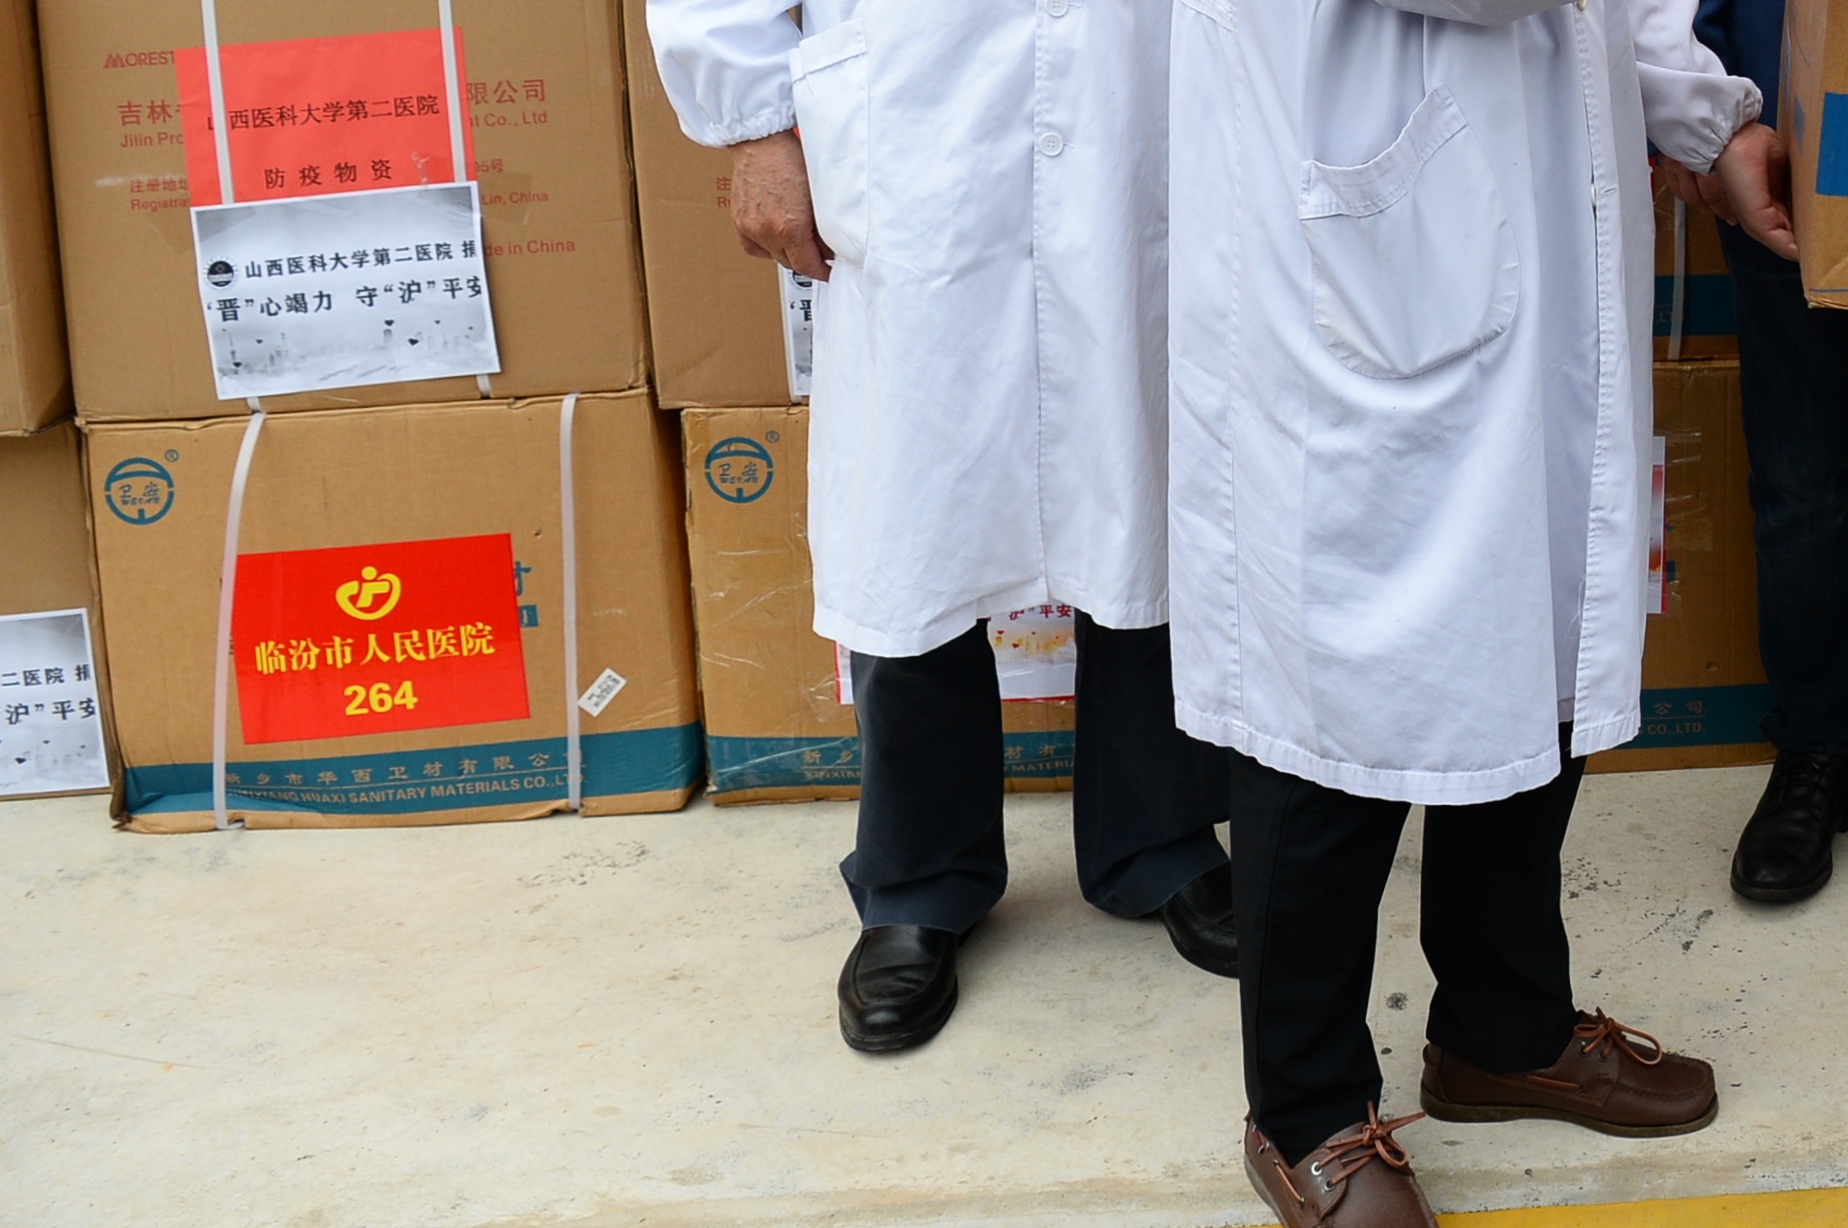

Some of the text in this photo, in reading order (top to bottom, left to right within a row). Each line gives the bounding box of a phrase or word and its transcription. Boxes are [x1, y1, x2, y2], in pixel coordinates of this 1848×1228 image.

[117, 100, 180, 127] 吉林
[522, 111, 548, 125] Ltd
[120, 133, 153, 148] Jilin
[264, 159, 392, 190] 防疫物资
[509, 191, 549, 204] China
[508, 242, 523, 256] in
[527, 239, 576, 254] China
[245, 242, 453, 280] 山西医科大学第二医院
[255, 621, 496, 675] 临汾市人民医院
[1, 667, 65, 687] 二医院
[344, 680, 419, 716] 264
[301, 790, 346, 804] HUAXI
[348, 784, 426, 805] SANITARY
[430, 779, 520, 801] MATERIALS
